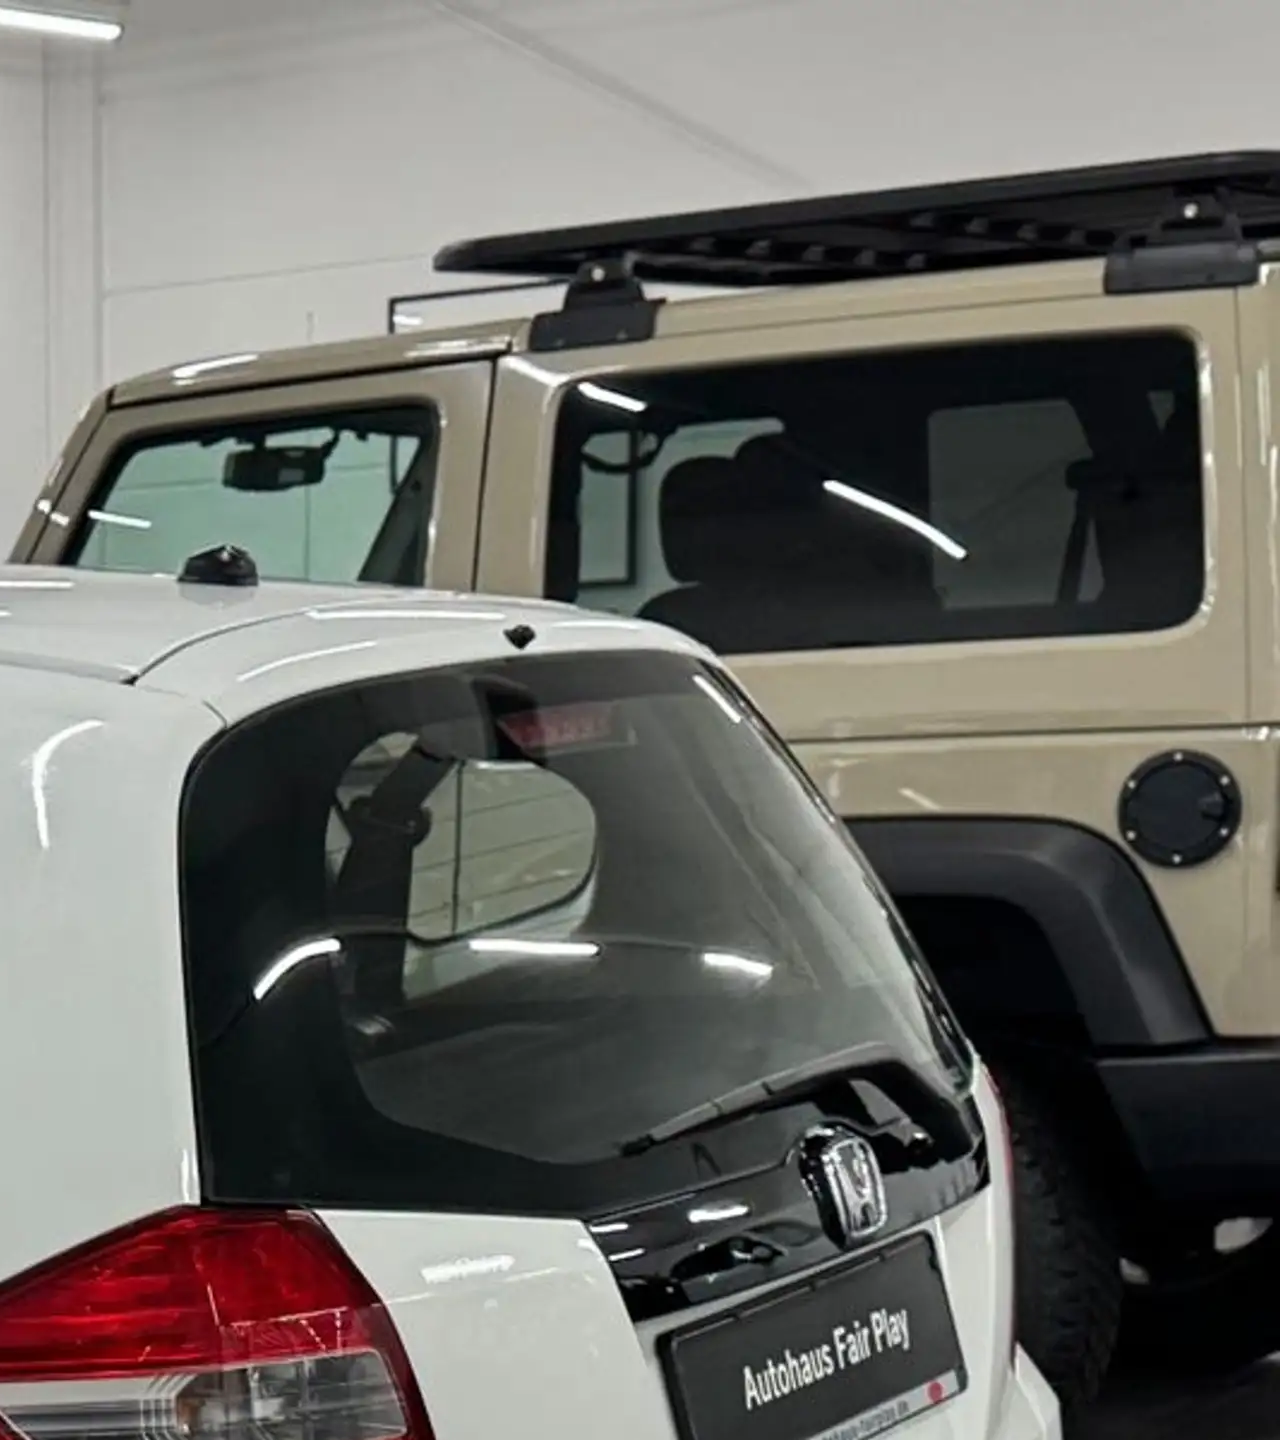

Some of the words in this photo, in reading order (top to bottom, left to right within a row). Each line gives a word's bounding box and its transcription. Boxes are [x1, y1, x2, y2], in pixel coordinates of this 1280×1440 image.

[743, 1348, 835, 1411] Autohaus
[833, 1319, 871, 1370] Fair
[869, 1308, 910, 1353] Play
